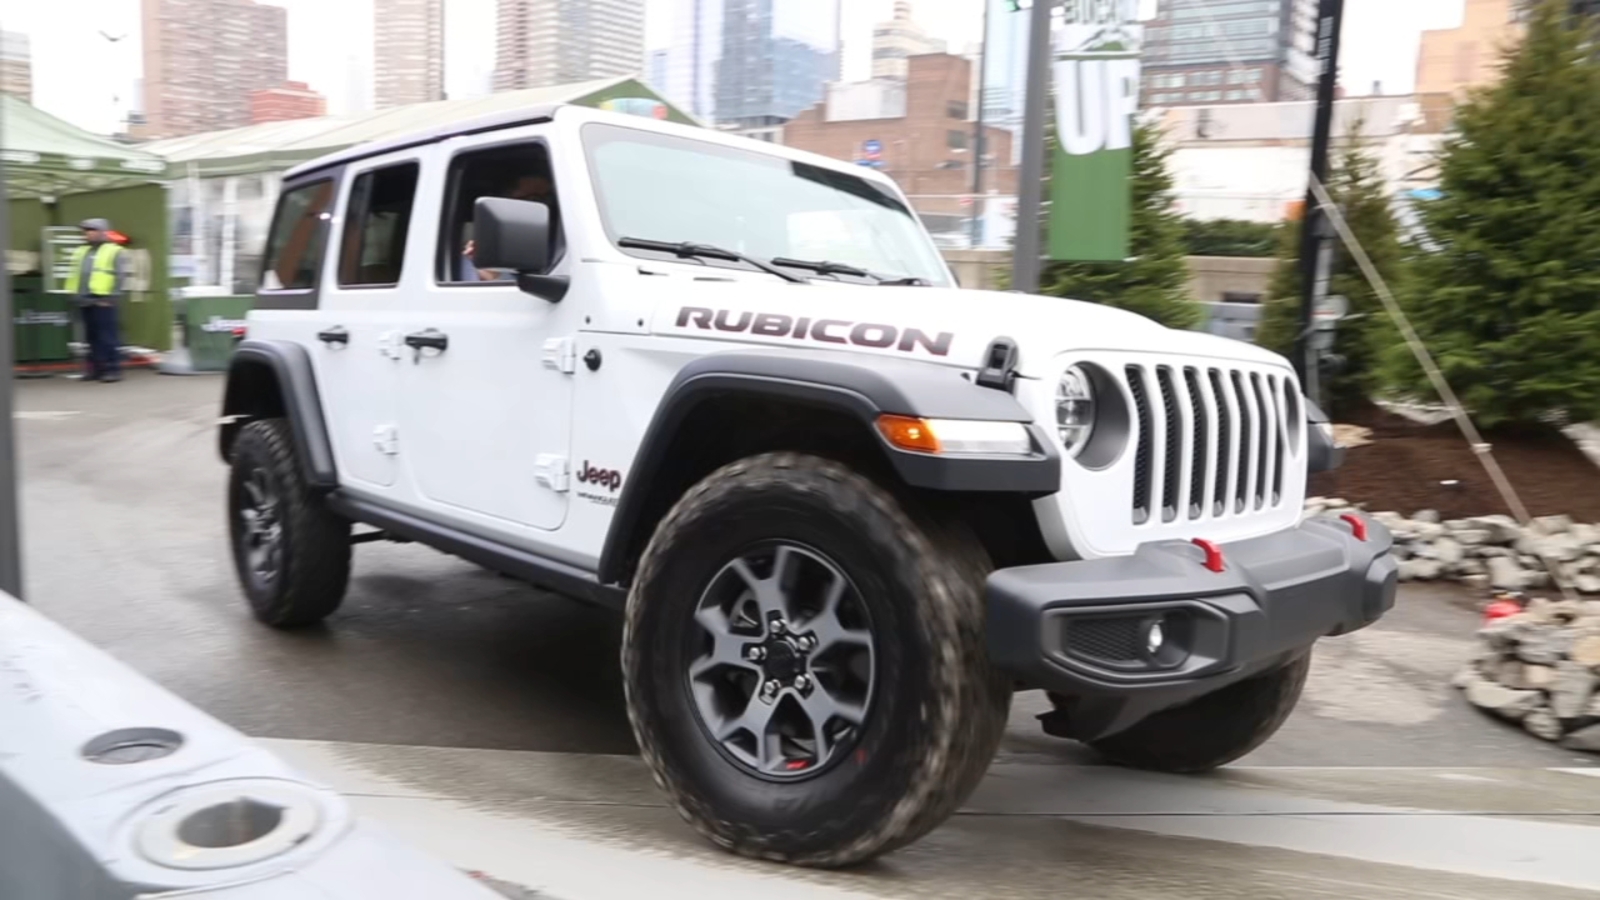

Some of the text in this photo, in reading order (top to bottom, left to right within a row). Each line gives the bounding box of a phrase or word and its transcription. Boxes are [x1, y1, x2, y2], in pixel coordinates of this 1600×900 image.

[1053, 58, 1141, 155] UP
[675, 306, 954, 356] RUBICON
[577, 460, 621, 492] Jeep
